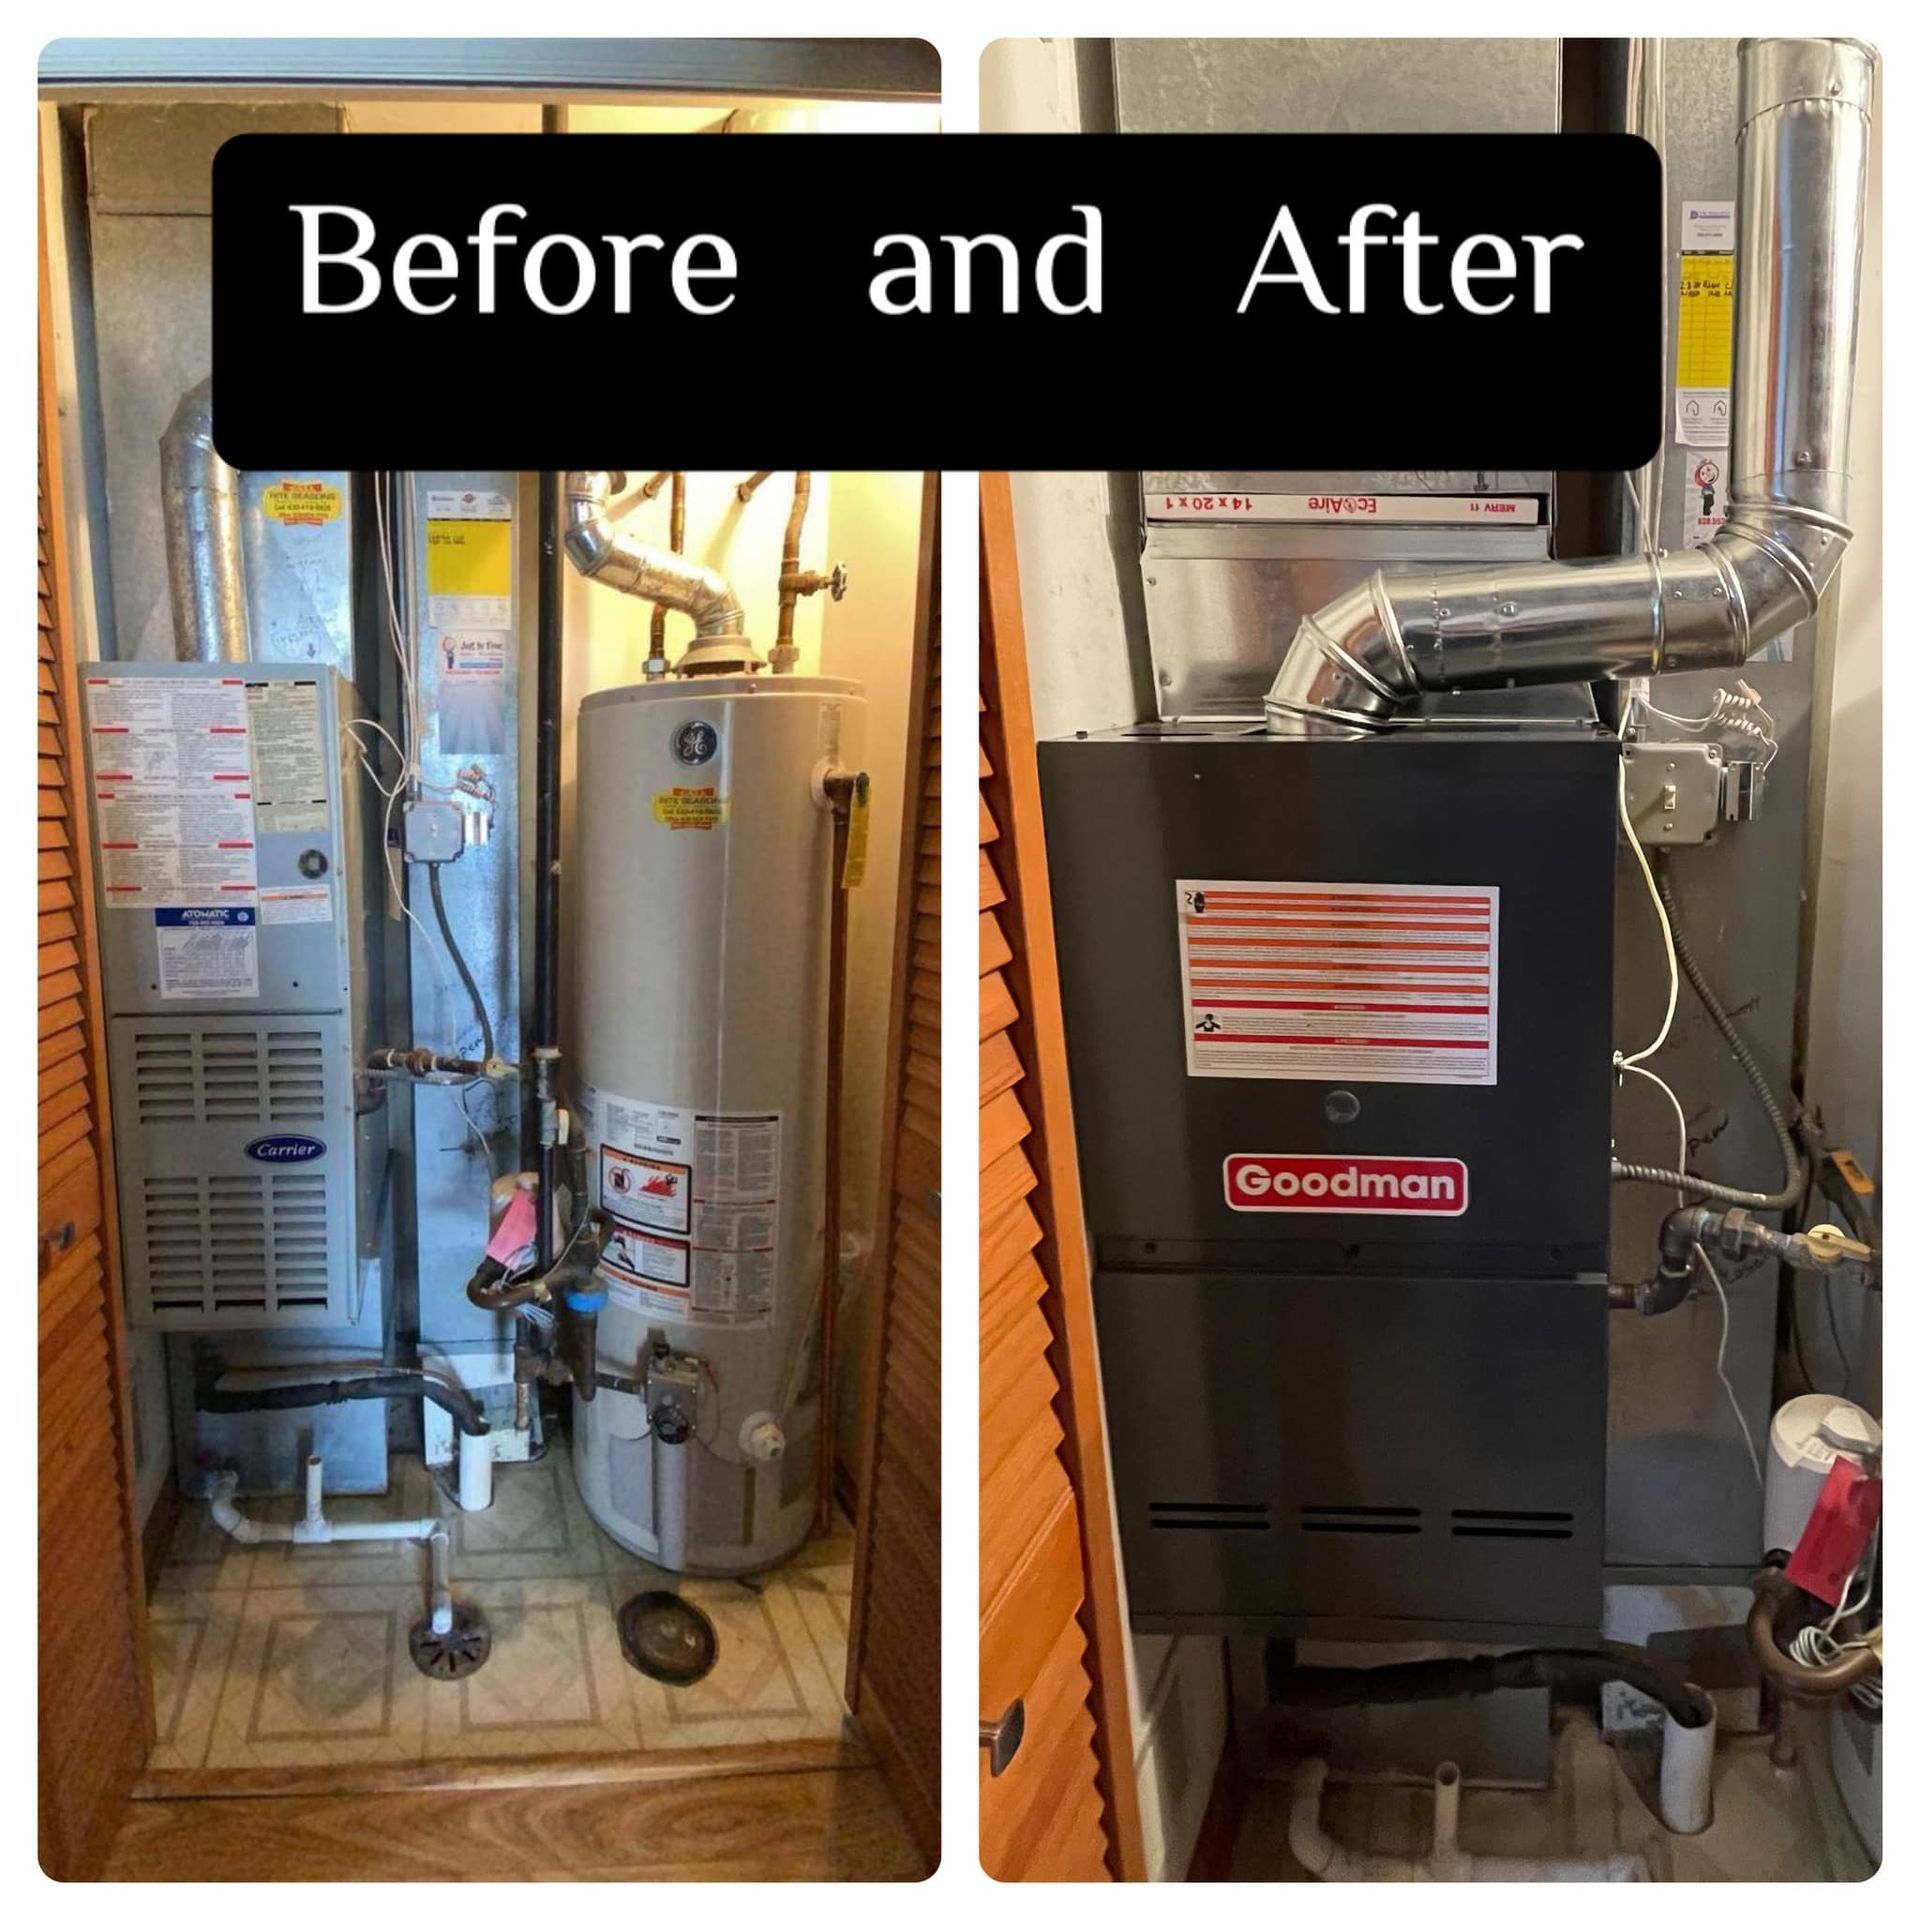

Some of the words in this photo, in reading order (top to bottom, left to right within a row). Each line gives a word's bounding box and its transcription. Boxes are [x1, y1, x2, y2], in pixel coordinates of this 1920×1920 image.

[1165, 497, 1174, 510] 1
[1178, 497, 1188, 508] x
[1193, 497, 1214, 510] 20
[1218, 497, 1228, 507] x
[1233, 497, 1252, 511] 14
[1470, 502, 1479, 512] 11
[1484, 503, 1516, 513] MERV
[257, 1143, 316, 1157] Carrier
[1236, 1164, 1455, 1200] Goodman
